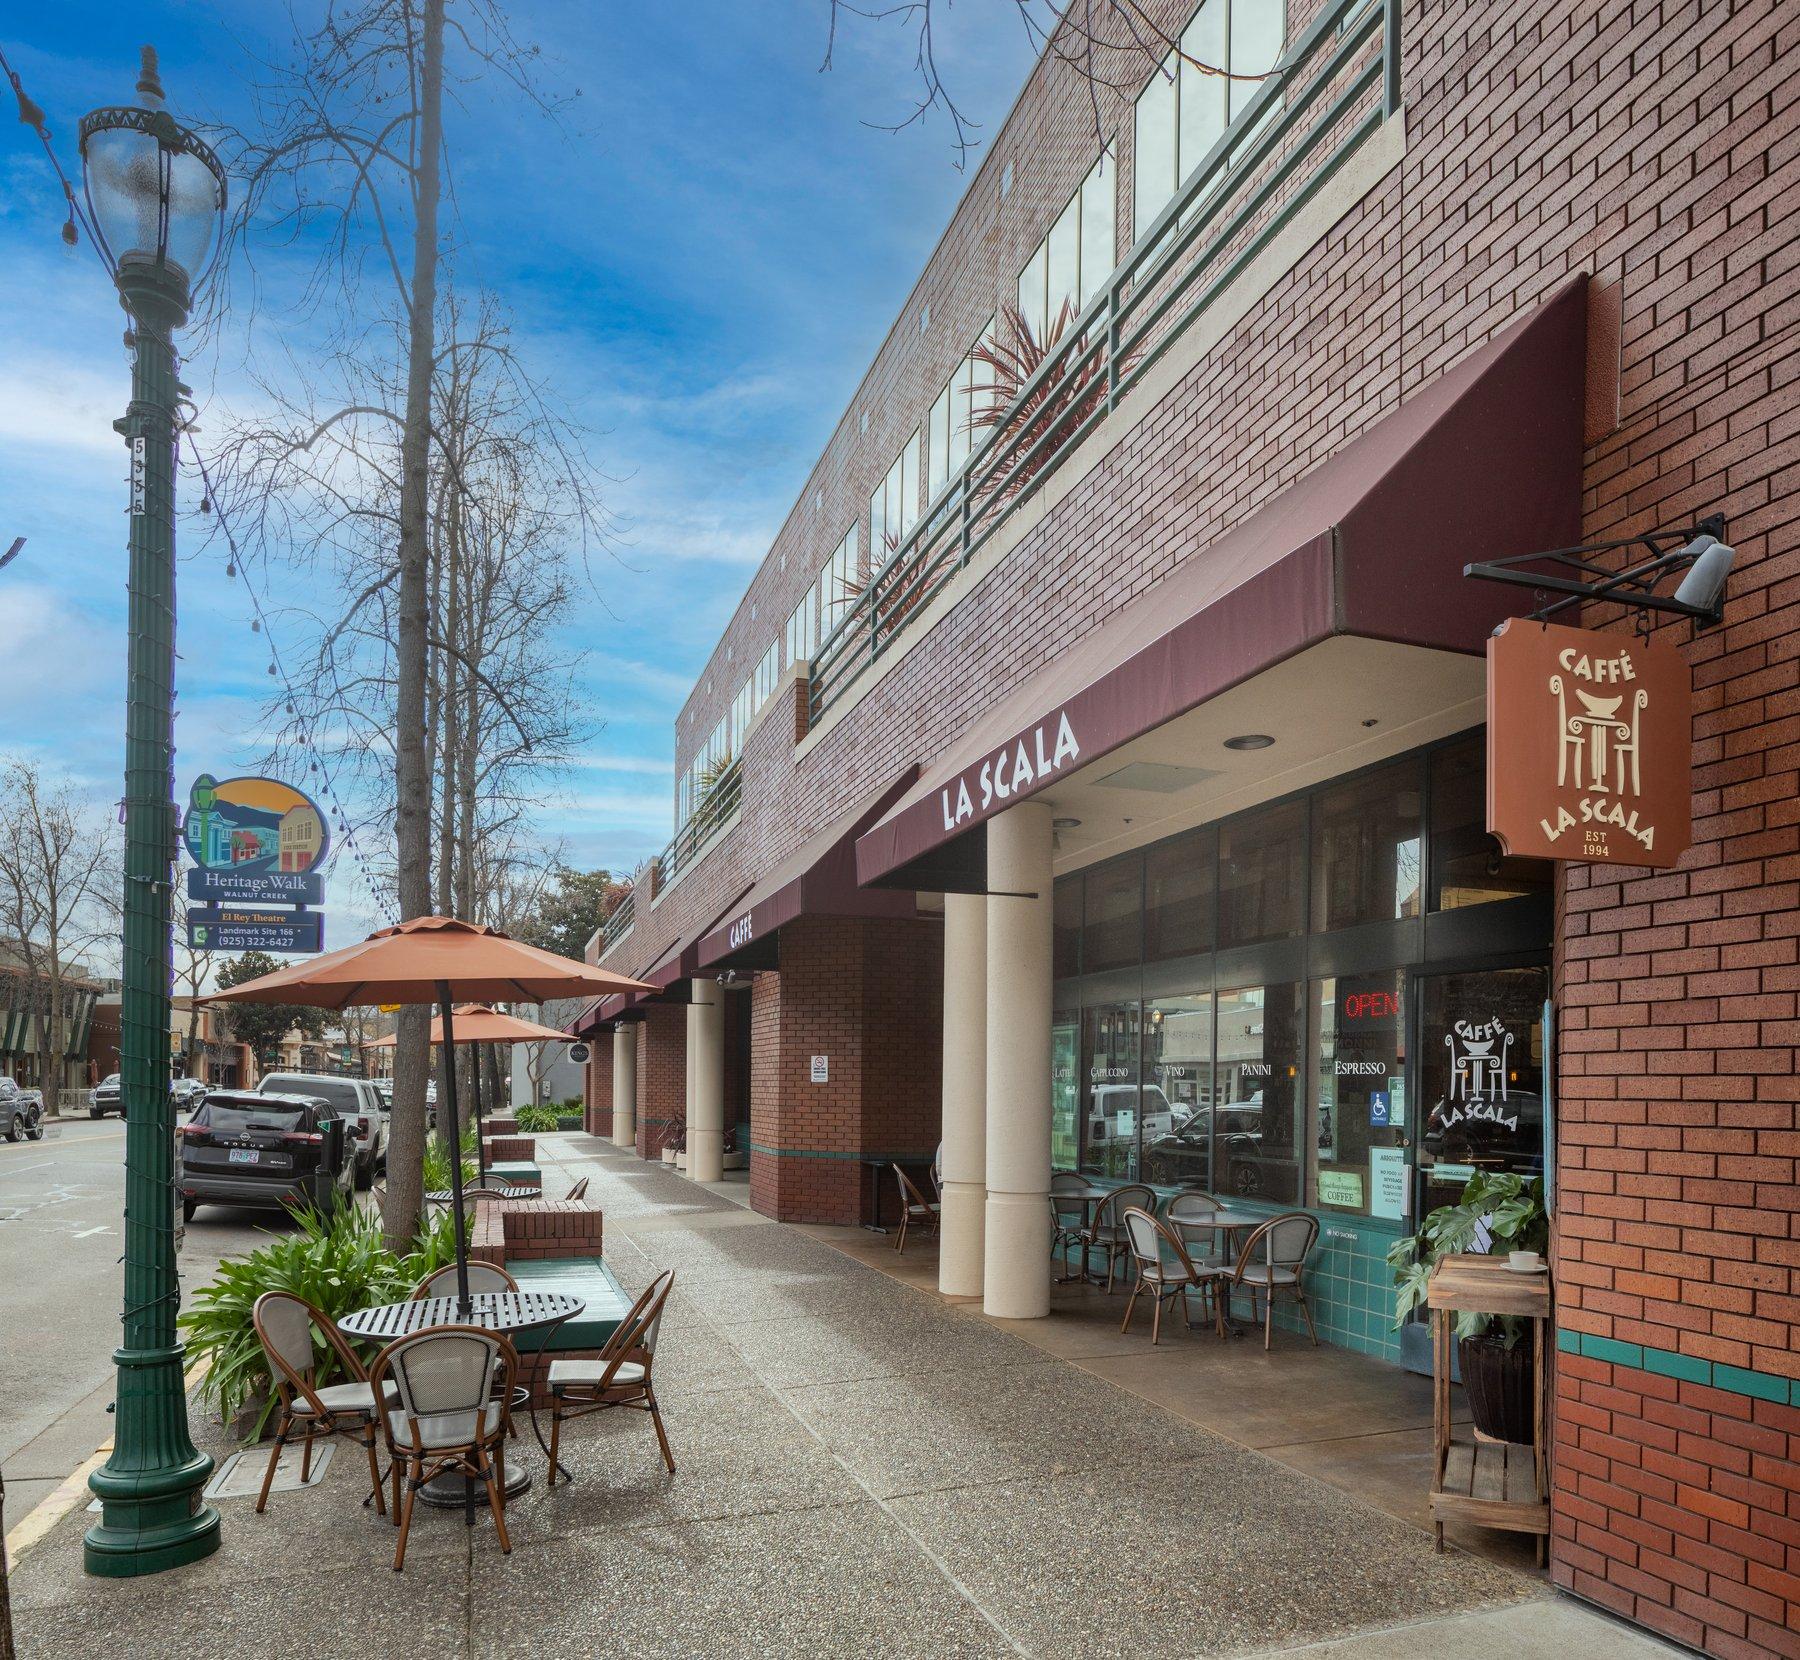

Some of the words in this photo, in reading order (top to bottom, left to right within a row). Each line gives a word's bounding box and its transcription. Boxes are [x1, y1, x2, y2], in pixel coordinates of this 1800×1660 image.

[942, 777, 974, 831] LA
[979, 710, 1080, 811] SCALA
[1540, 806, 1577, 842] LA
[1578, 797, 1655, 851] SCALA
[1585, 830, 1607, 843] EST
[1583, 844, 1609, 857] 1994
[205, 872, 268, 892] Heritage
[268, 875, 307, 890] Walk
[223, 891, 258, 899] WALNUT
[222, 913, 231, 921] El
[233, 913, 252, 924] Rey
[252, 913, 286, 923] Theatre
[219, 926, 259, 935] Landmark
[261, 927, 277, 935] Site
[219, 936, 245, 947] (925)
[246, 937, 294, 947] 322-6427
[1345, 991, 1399, 1019] OPEN
[1454, 1015, 1505, 1041] CAFFÉ
[1165, 1065, 1185, 1077] VINO
[1241, 1063, 1272, 1076] PANINI
[1334, 1060, 1386, 1075] ESPRESSO
[1440, 1106, 1464, 1129] LA
[1464, 1103, 1518, 1132] SCALA
[1327, 1190, 1354, 1203] COFFEE
